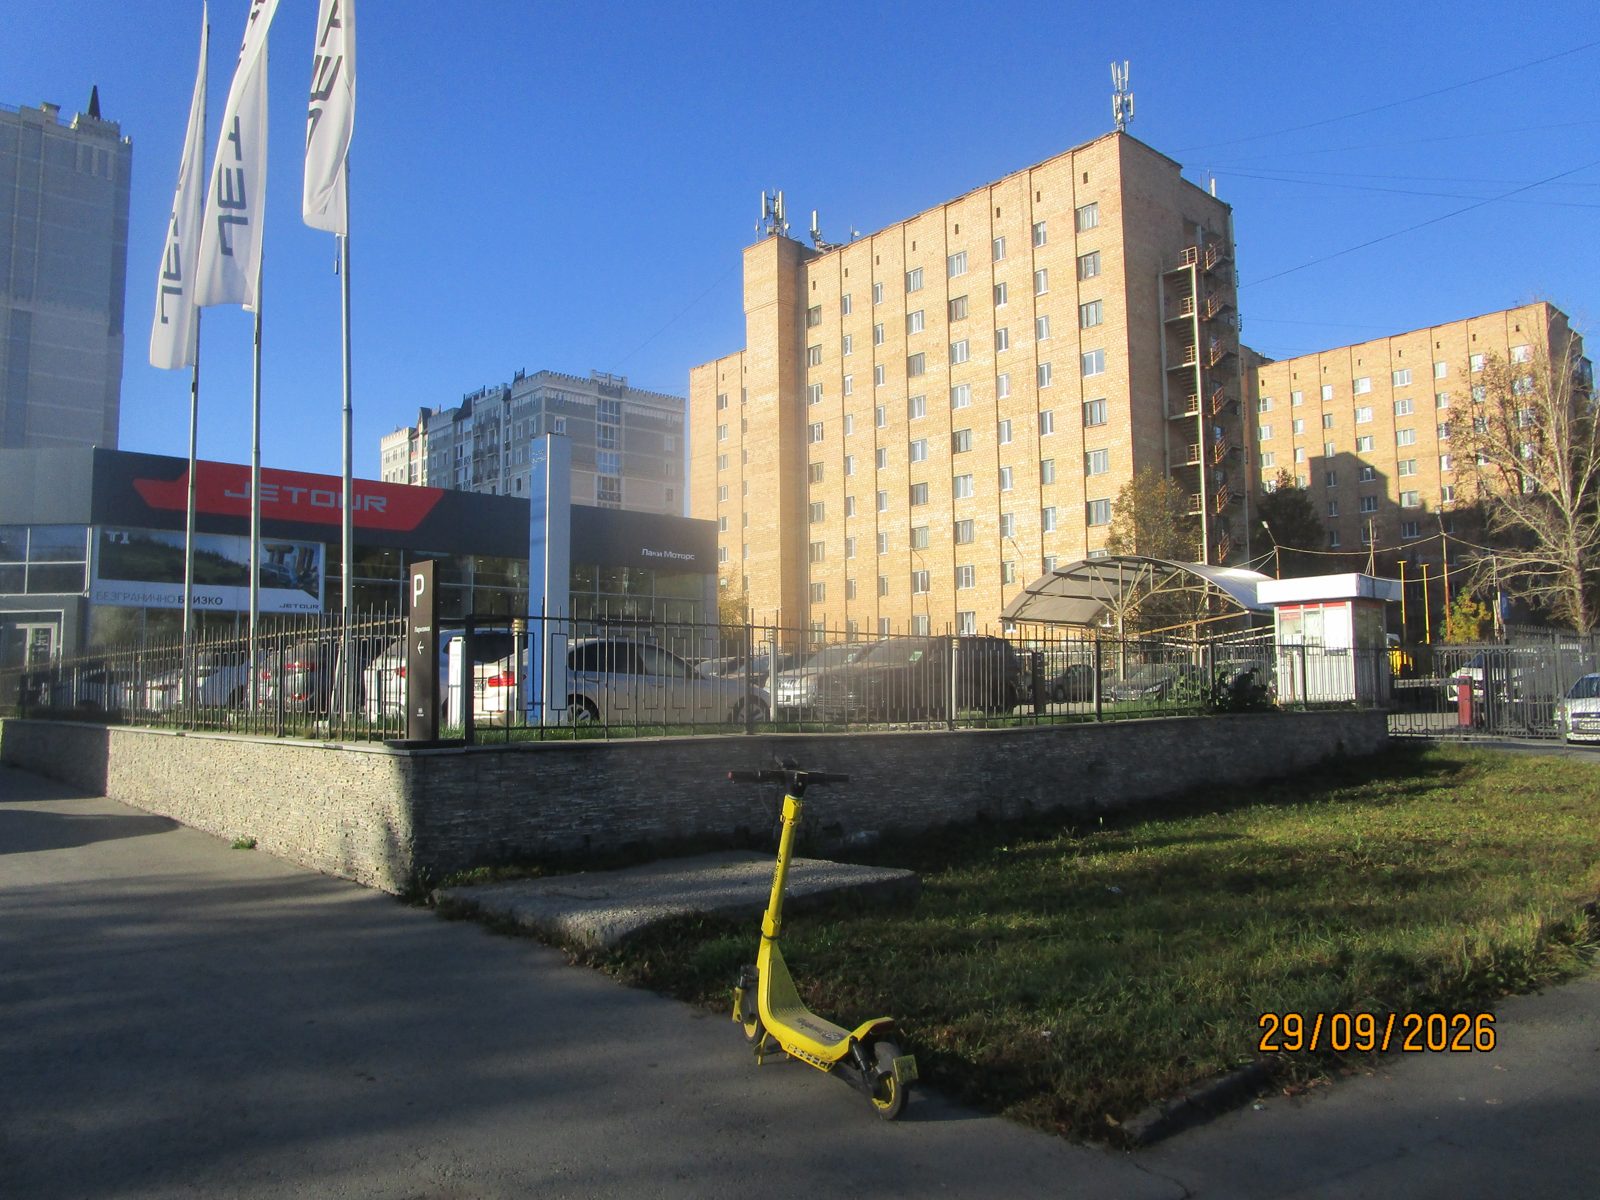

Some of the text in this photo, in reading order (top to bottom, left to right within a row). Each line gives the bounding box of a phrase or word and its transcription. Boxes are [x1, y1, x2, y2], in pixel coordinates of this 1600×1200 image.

[224, 481, 387, 513] JETOUR
[663, 550, 696, 561] Моторс
[96, 591, 223, 606] БЕЗГРАНИЧНО БИЗКО
